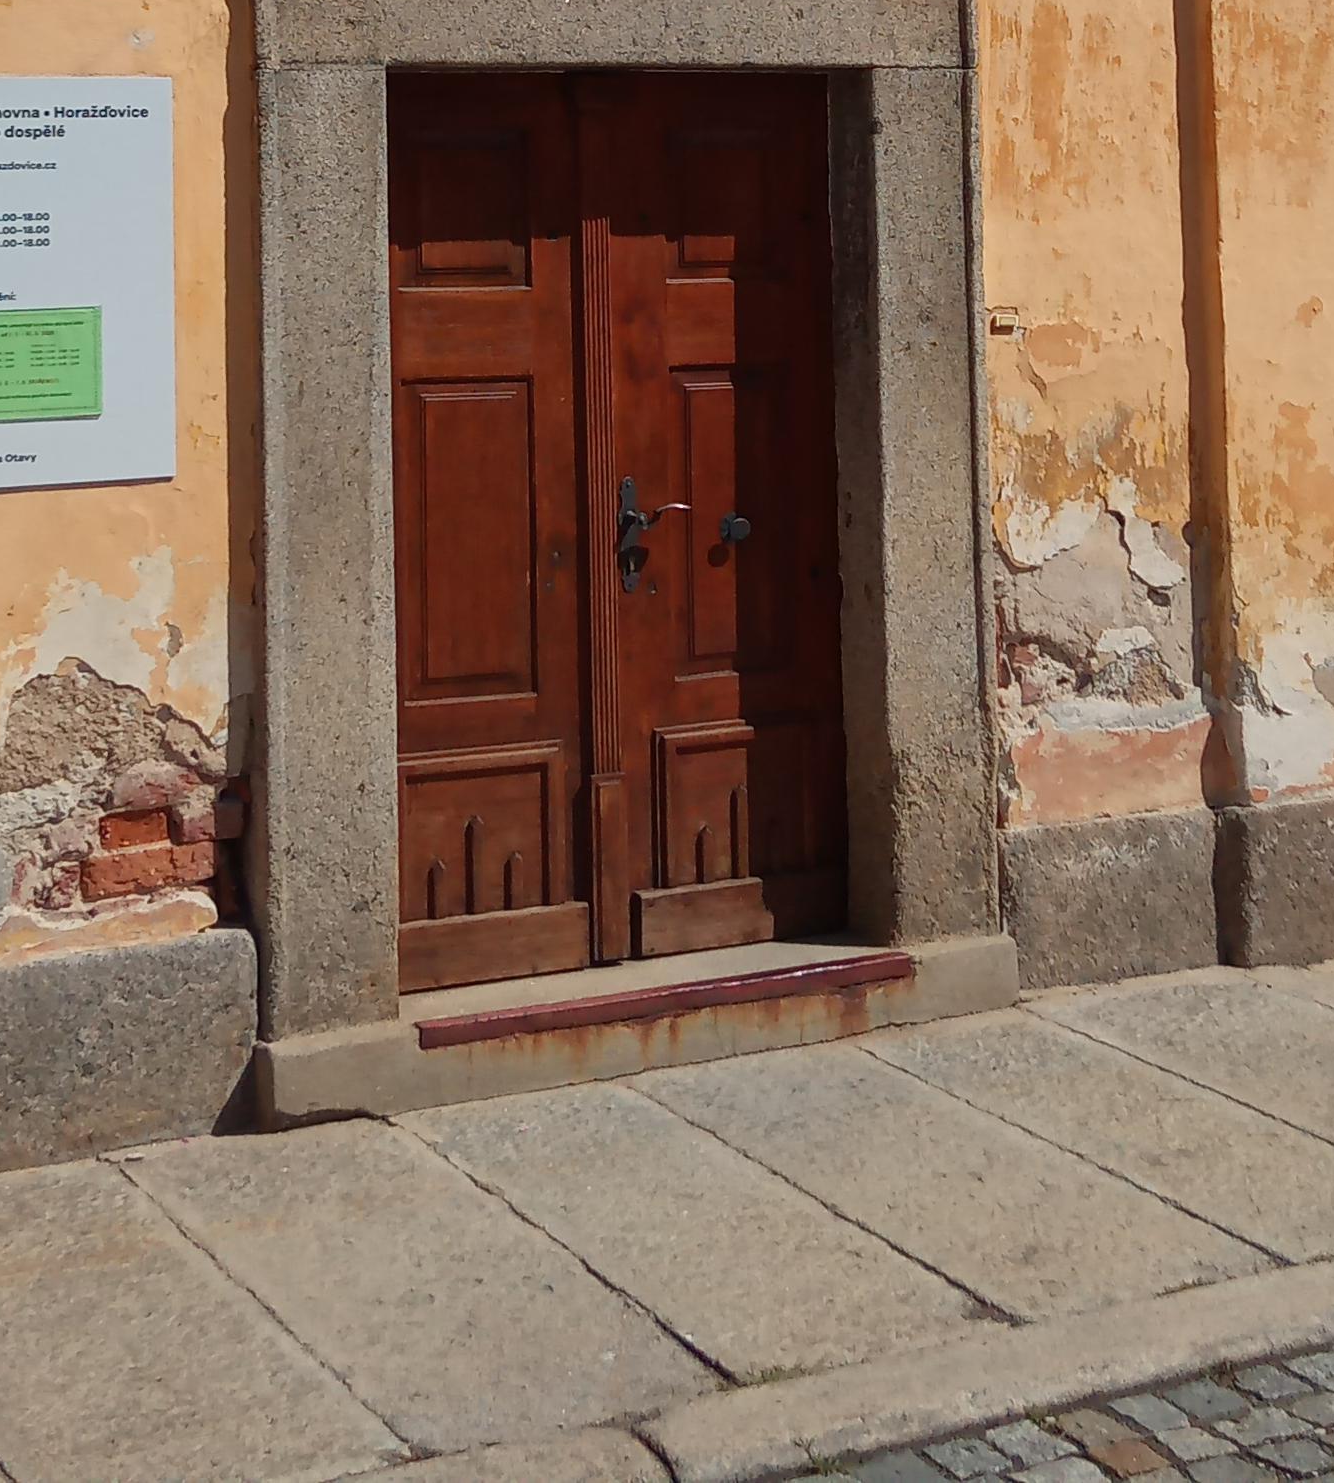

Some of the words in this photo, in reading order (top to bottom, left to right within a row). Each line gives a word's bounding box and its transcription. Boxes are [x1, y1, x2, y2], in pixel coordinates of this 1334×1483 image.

[54, 106, 149, 119] Horažďovice
[4, 125, 66, 140] dospělé
[5, 453, 37, 463] Otavy
